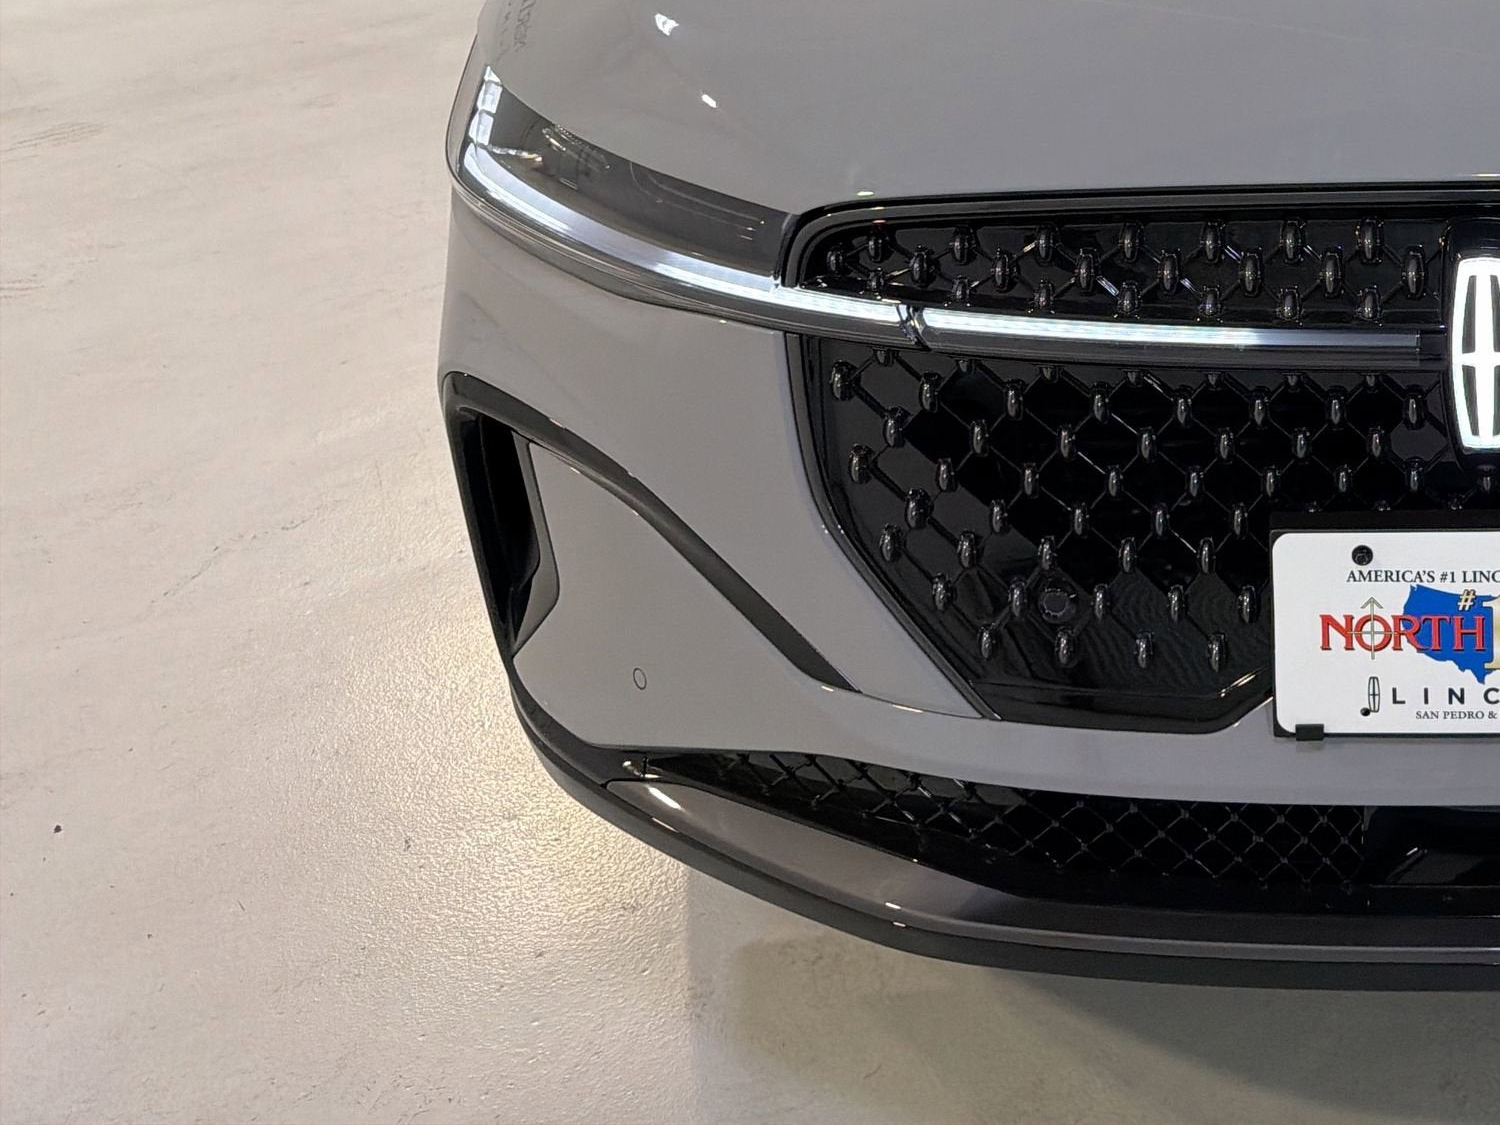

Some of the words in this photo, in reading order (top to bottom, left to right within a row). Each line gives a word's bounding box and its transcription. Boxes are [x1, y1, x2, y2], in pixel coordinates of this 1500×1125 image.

[1346, 568, 1436, 584] AMERICA'S
[1439, 569, 1456, 584] #1
[1319, 613, 1485, 652] NORTH
[1415, 710, 1441, 721] SAN
[1443, 710, 1486, 721] PEDRO
[1488, 709, 1498, 720] &
